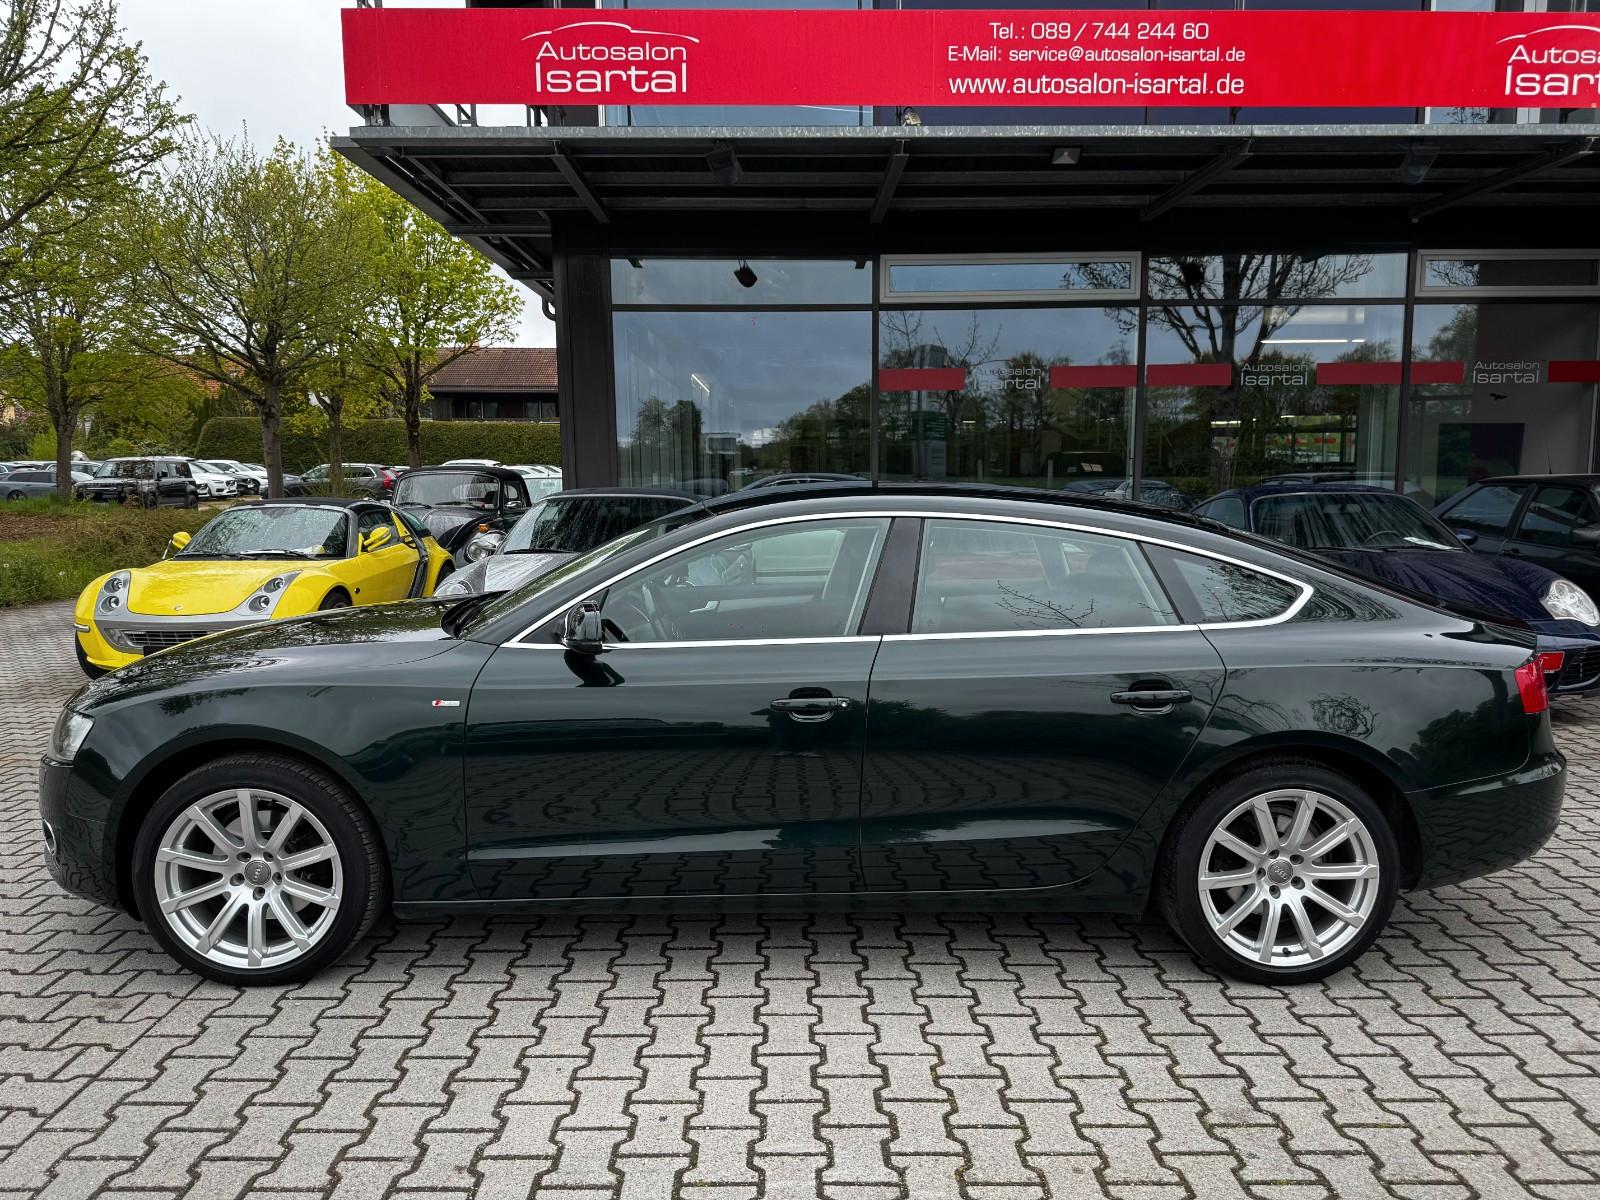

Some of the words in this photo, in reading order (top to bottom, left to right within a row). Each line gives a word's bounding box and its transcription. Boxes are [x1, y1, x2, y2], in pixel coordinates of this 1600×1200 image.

[989, 22, 1025, 40] Tel.:
[1031, 22, 1071, 40] 089
[1092, 22, 1131, 40] 744
[1137, 22, 1176, 40] 244
[1182, 22, 1209, 40] 60
[536, 41, 687, 61] Autosalon
[947, 45, 1002, 62] E-Mail:
[1008, 45, 1246, 62] service@autosalon-isartal.de
[1508, 44, 1600, 64] Autos
[535, 62, 687, 93] Isartal
[948, 72, 1246, 95] www.autosalon-isartal.de
[1504, 64, 1600, 96] Isar
[1241, 362, 1308, 372] Autosalon
[1473, 360, 1540, 370] Autosalon
[1240, 371, 1308, 386] Isartal
[1472, 369, 1540, 384] Isartal
